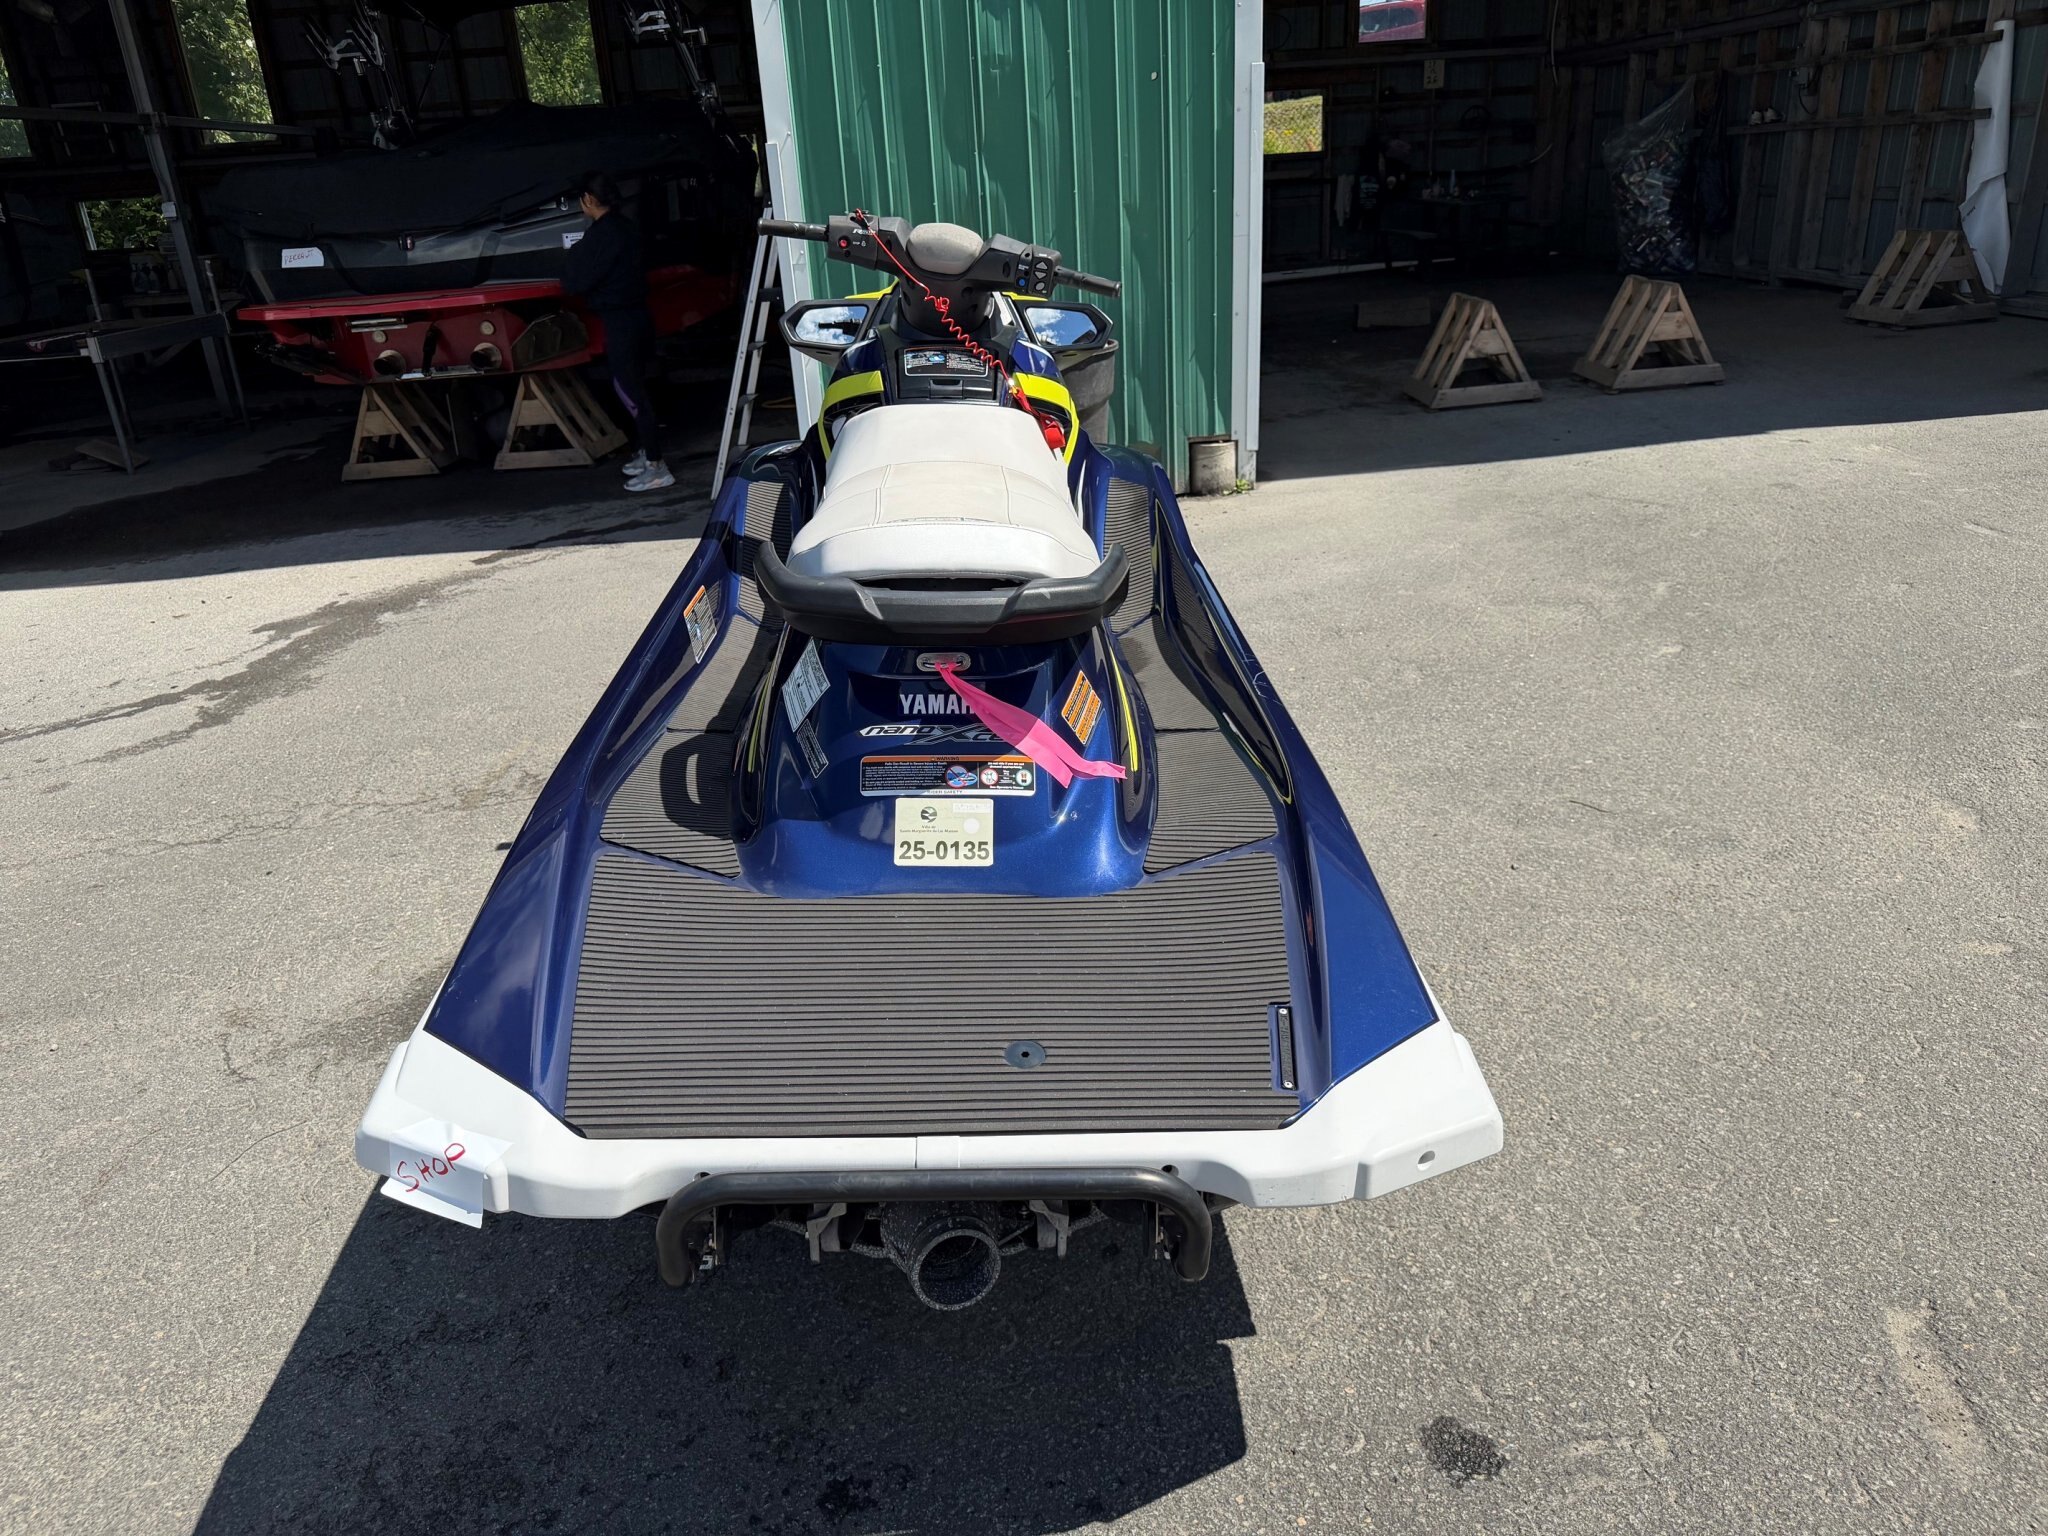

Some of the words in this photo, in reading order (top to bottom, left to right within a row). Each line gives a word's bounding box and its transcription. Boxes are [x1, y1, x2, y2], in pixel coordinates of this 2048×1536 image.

[899, 694, 975, 714] YAMAH
[899, 840, 990, 860] 25-0135
[397, 1143, 466, 1192] SHOP
